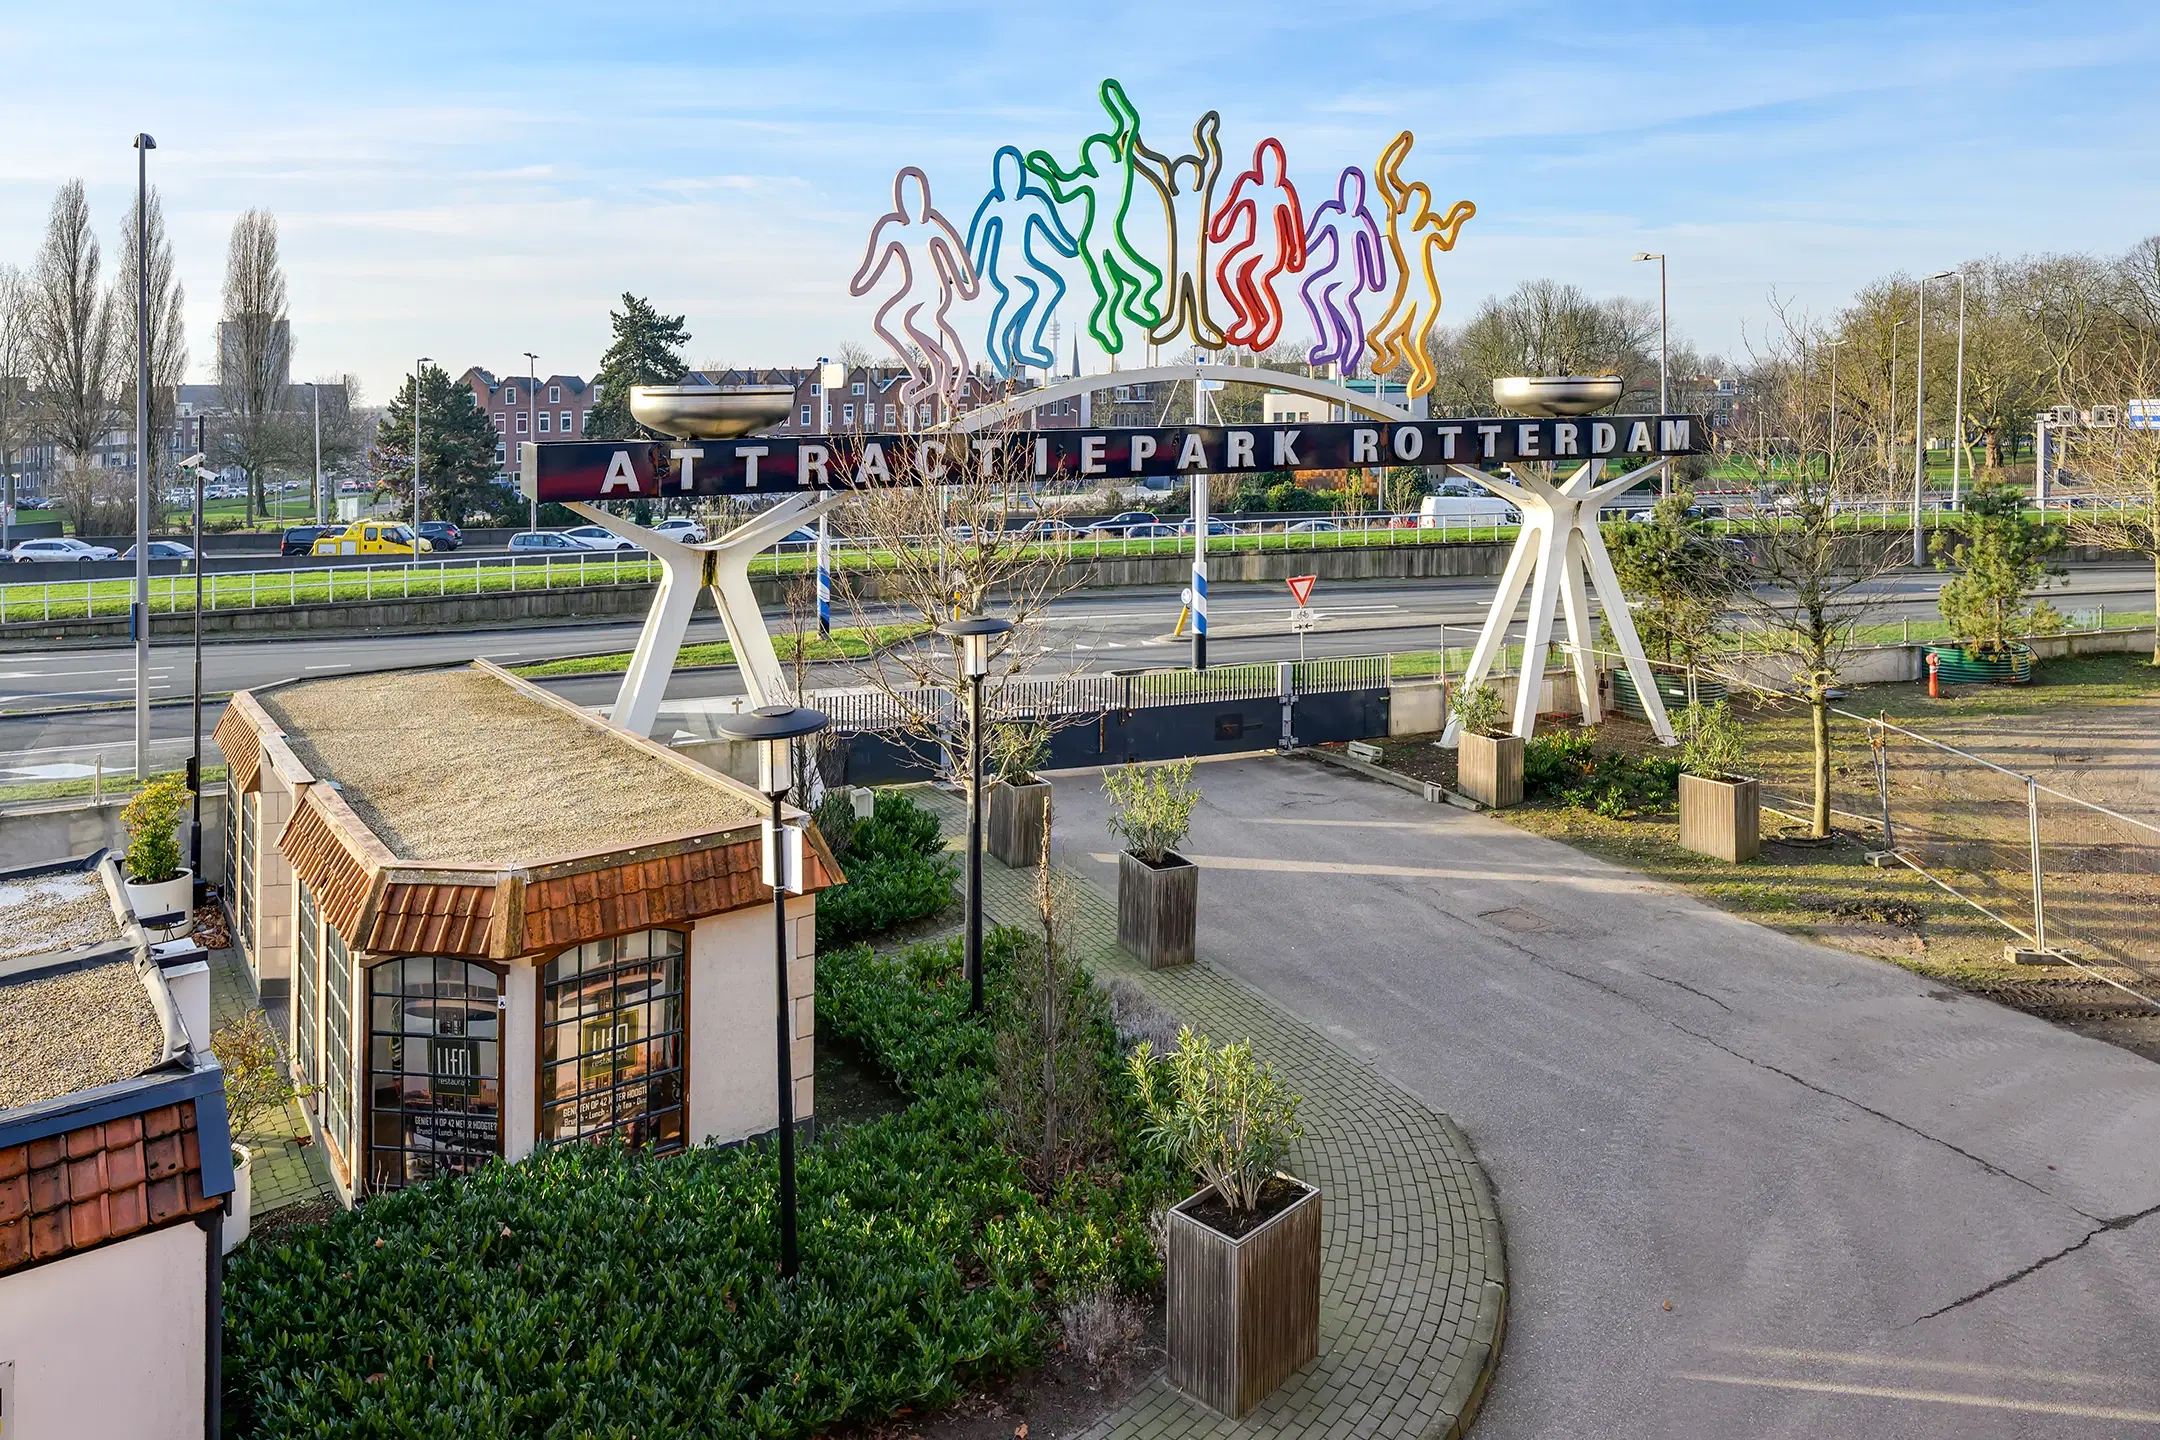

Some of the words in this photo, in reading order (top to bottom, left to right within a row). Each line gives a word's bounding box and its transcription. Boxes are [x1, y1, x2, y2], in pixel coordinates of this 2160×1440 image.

[600, 430, 1300, 493] ATTRACTIEPARK
[1353, 420, 1690, 463] ROTTERDAM
[591, 1052, 627, 1067] restauant
[437, 1078, 471, 1087] restaurat
[563, 1101, 590, 1117] GENITEN
[600, 1097, 607, 1107] 42
[609, 1091, 626, 1104] MTER
[415, 1116, 438, 1126] GENIETN
[439, 1118, 447, 1127] OP
[448, 1119, 454, 1128] 42
[456, 1120, 472, 1129] METR
[564, 1114, 584, 1126] Brunh
